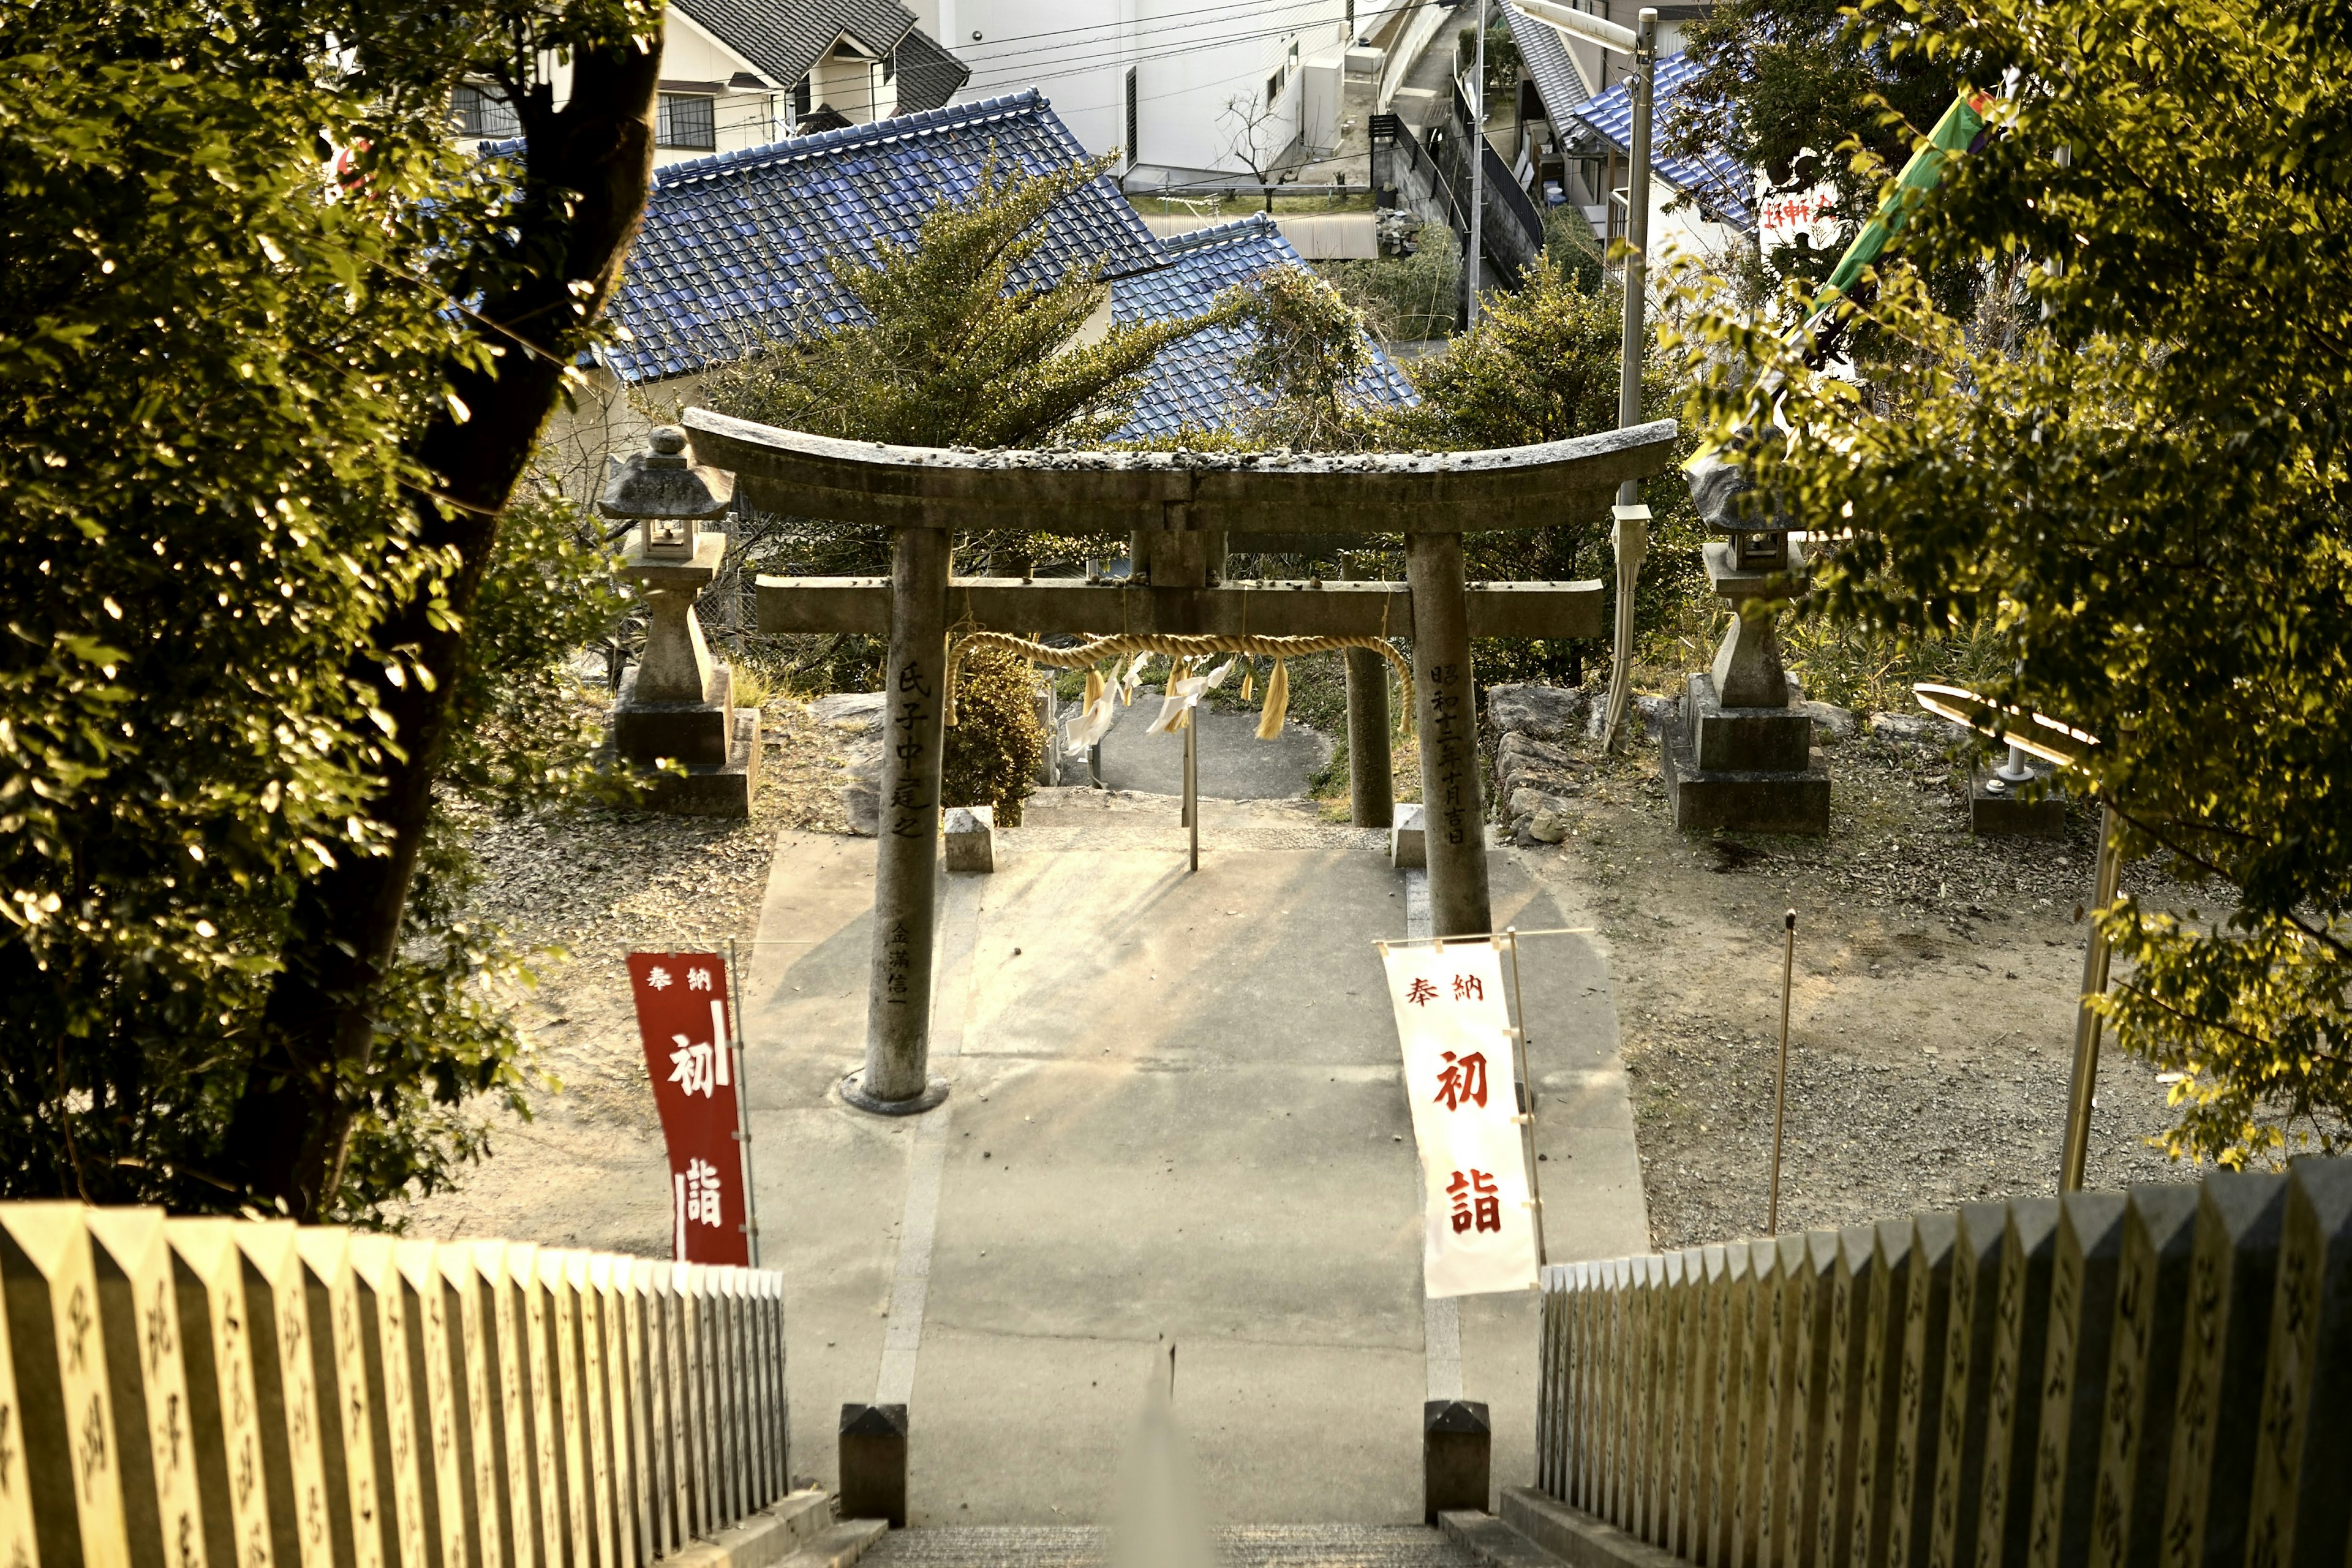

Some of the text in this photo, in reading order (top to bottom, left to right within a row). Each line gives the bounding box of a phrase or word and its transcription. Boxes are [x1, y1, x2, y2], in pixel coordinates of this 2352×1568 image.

[647, 967, 713, 992] 奉納
[1406, 973, 1484, 1008] 奉納
[668, 1033, 722, 1228] 初詣
[1433, 1050, 1501, 1234] 初詣
